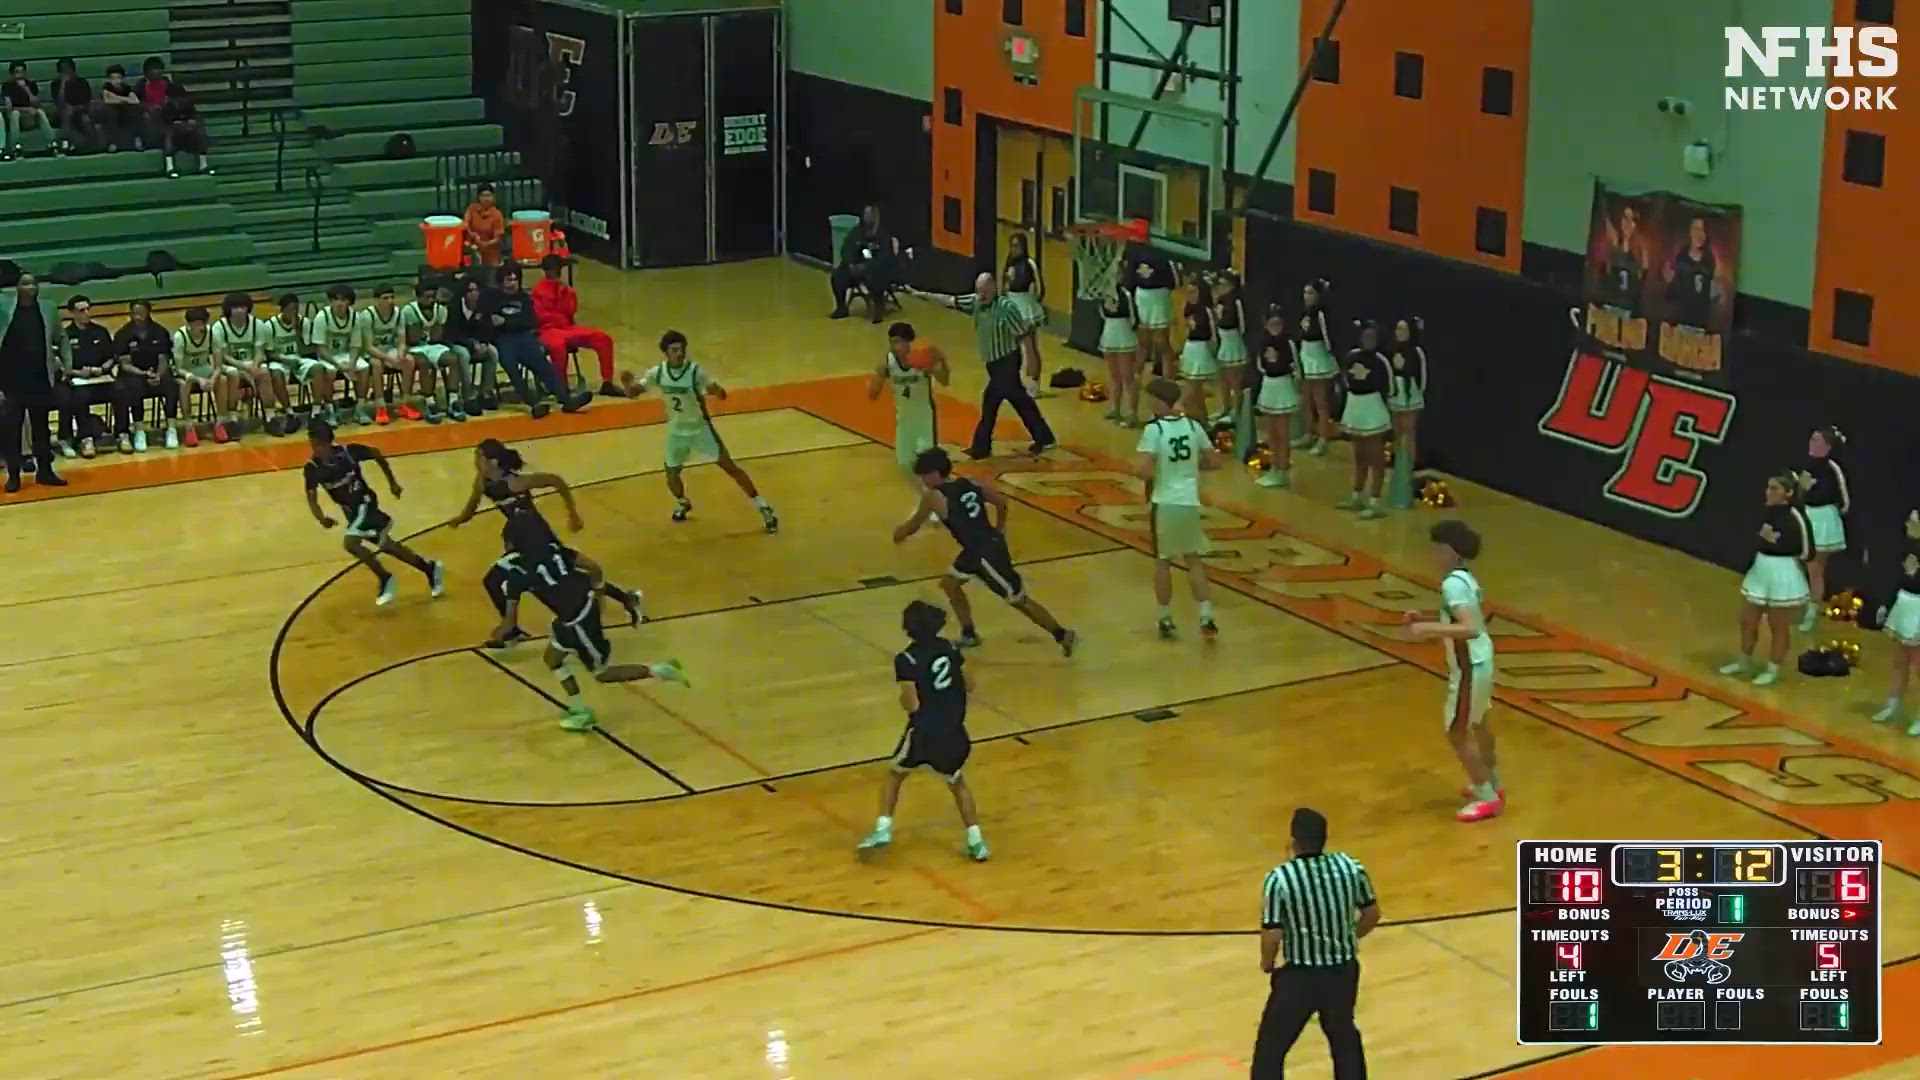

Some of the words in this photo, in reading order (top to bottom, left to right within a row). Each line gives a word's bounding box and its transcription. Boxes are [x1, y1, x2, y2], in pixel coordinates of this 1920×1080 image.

[723, 127, 767, 146] EDGE
[671, 396, 684, 413] 2
[901, 384, 911, 401] 4
[1167, 434, 1192, 463] 35
[959, 490, 981, 519] 3
[536, 553, 570, 587] 11
[931, 655, 953, 691] 2
